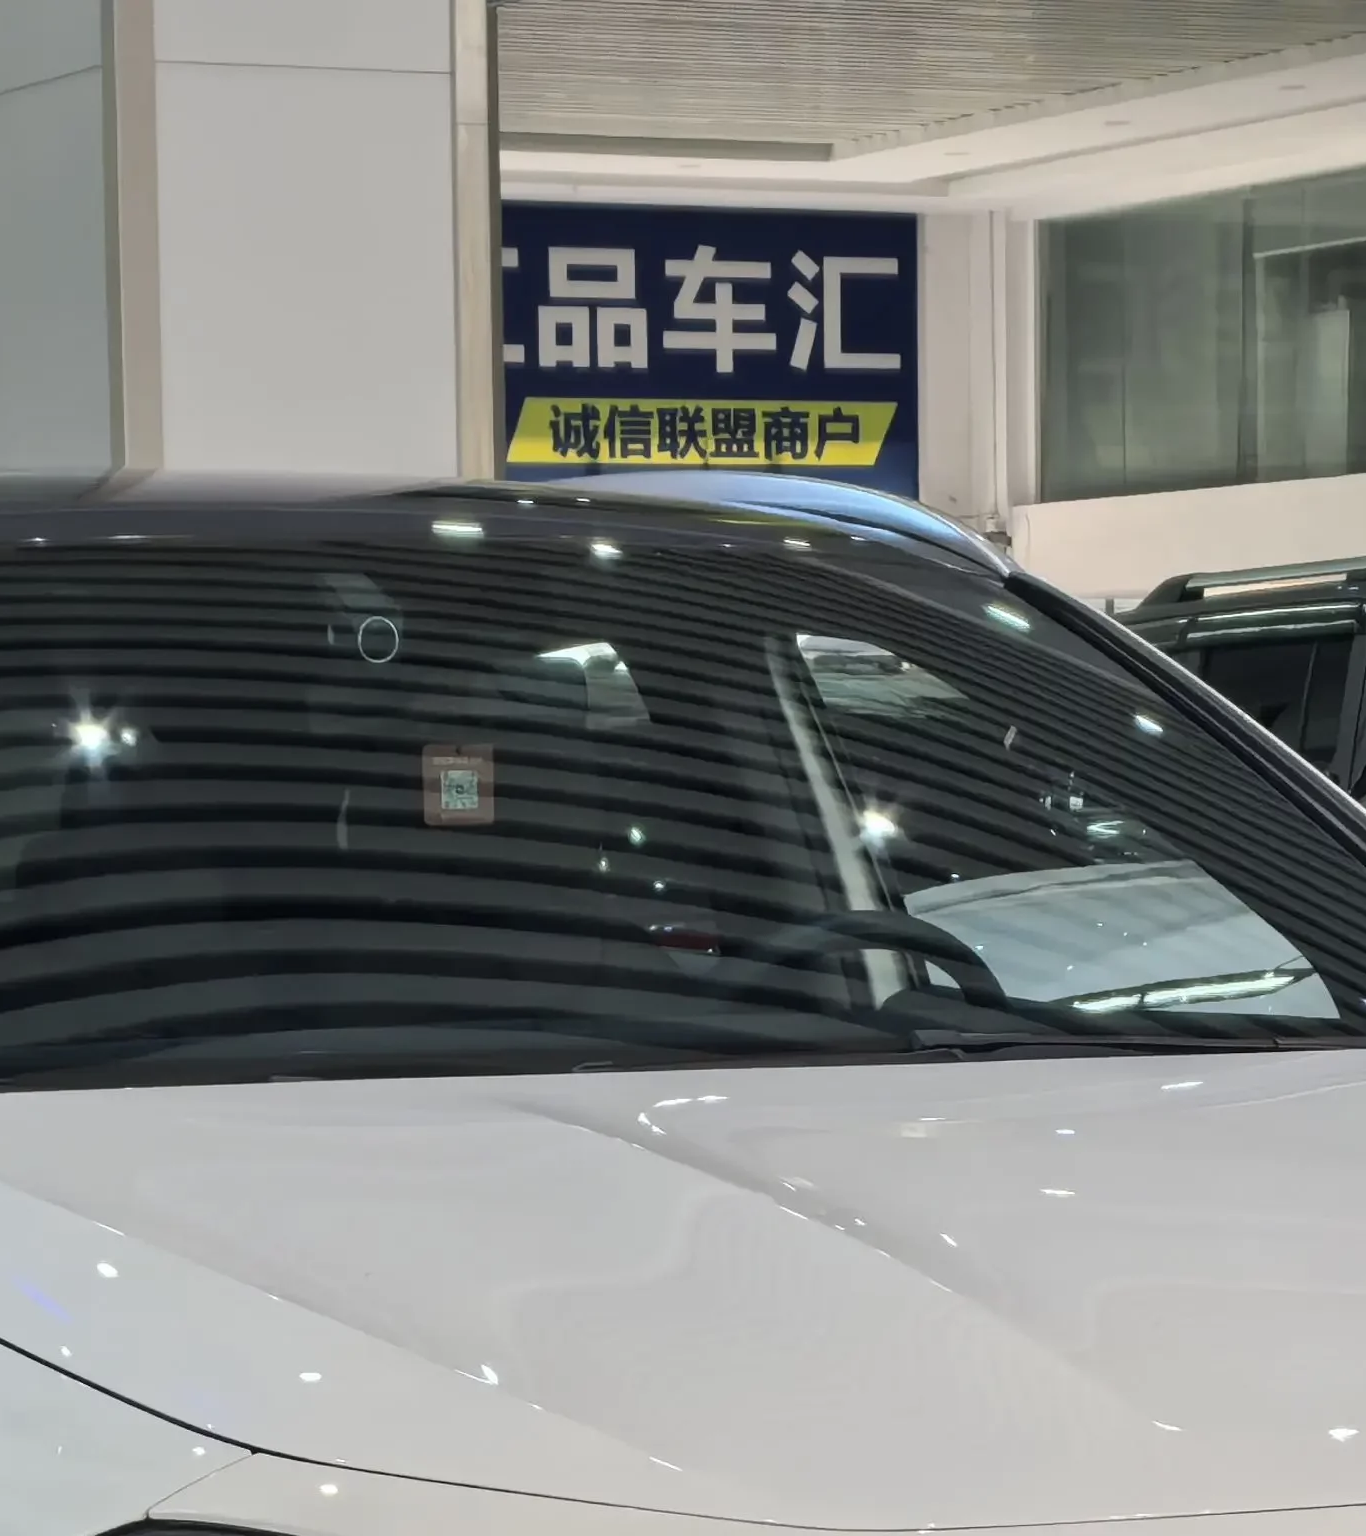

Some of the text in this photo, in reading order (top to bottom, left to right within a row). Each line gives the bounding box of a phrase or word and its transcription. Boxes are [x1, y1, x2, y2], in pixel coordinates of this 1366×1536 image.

[548, 404, 861, 461] 诚信联盟商户
